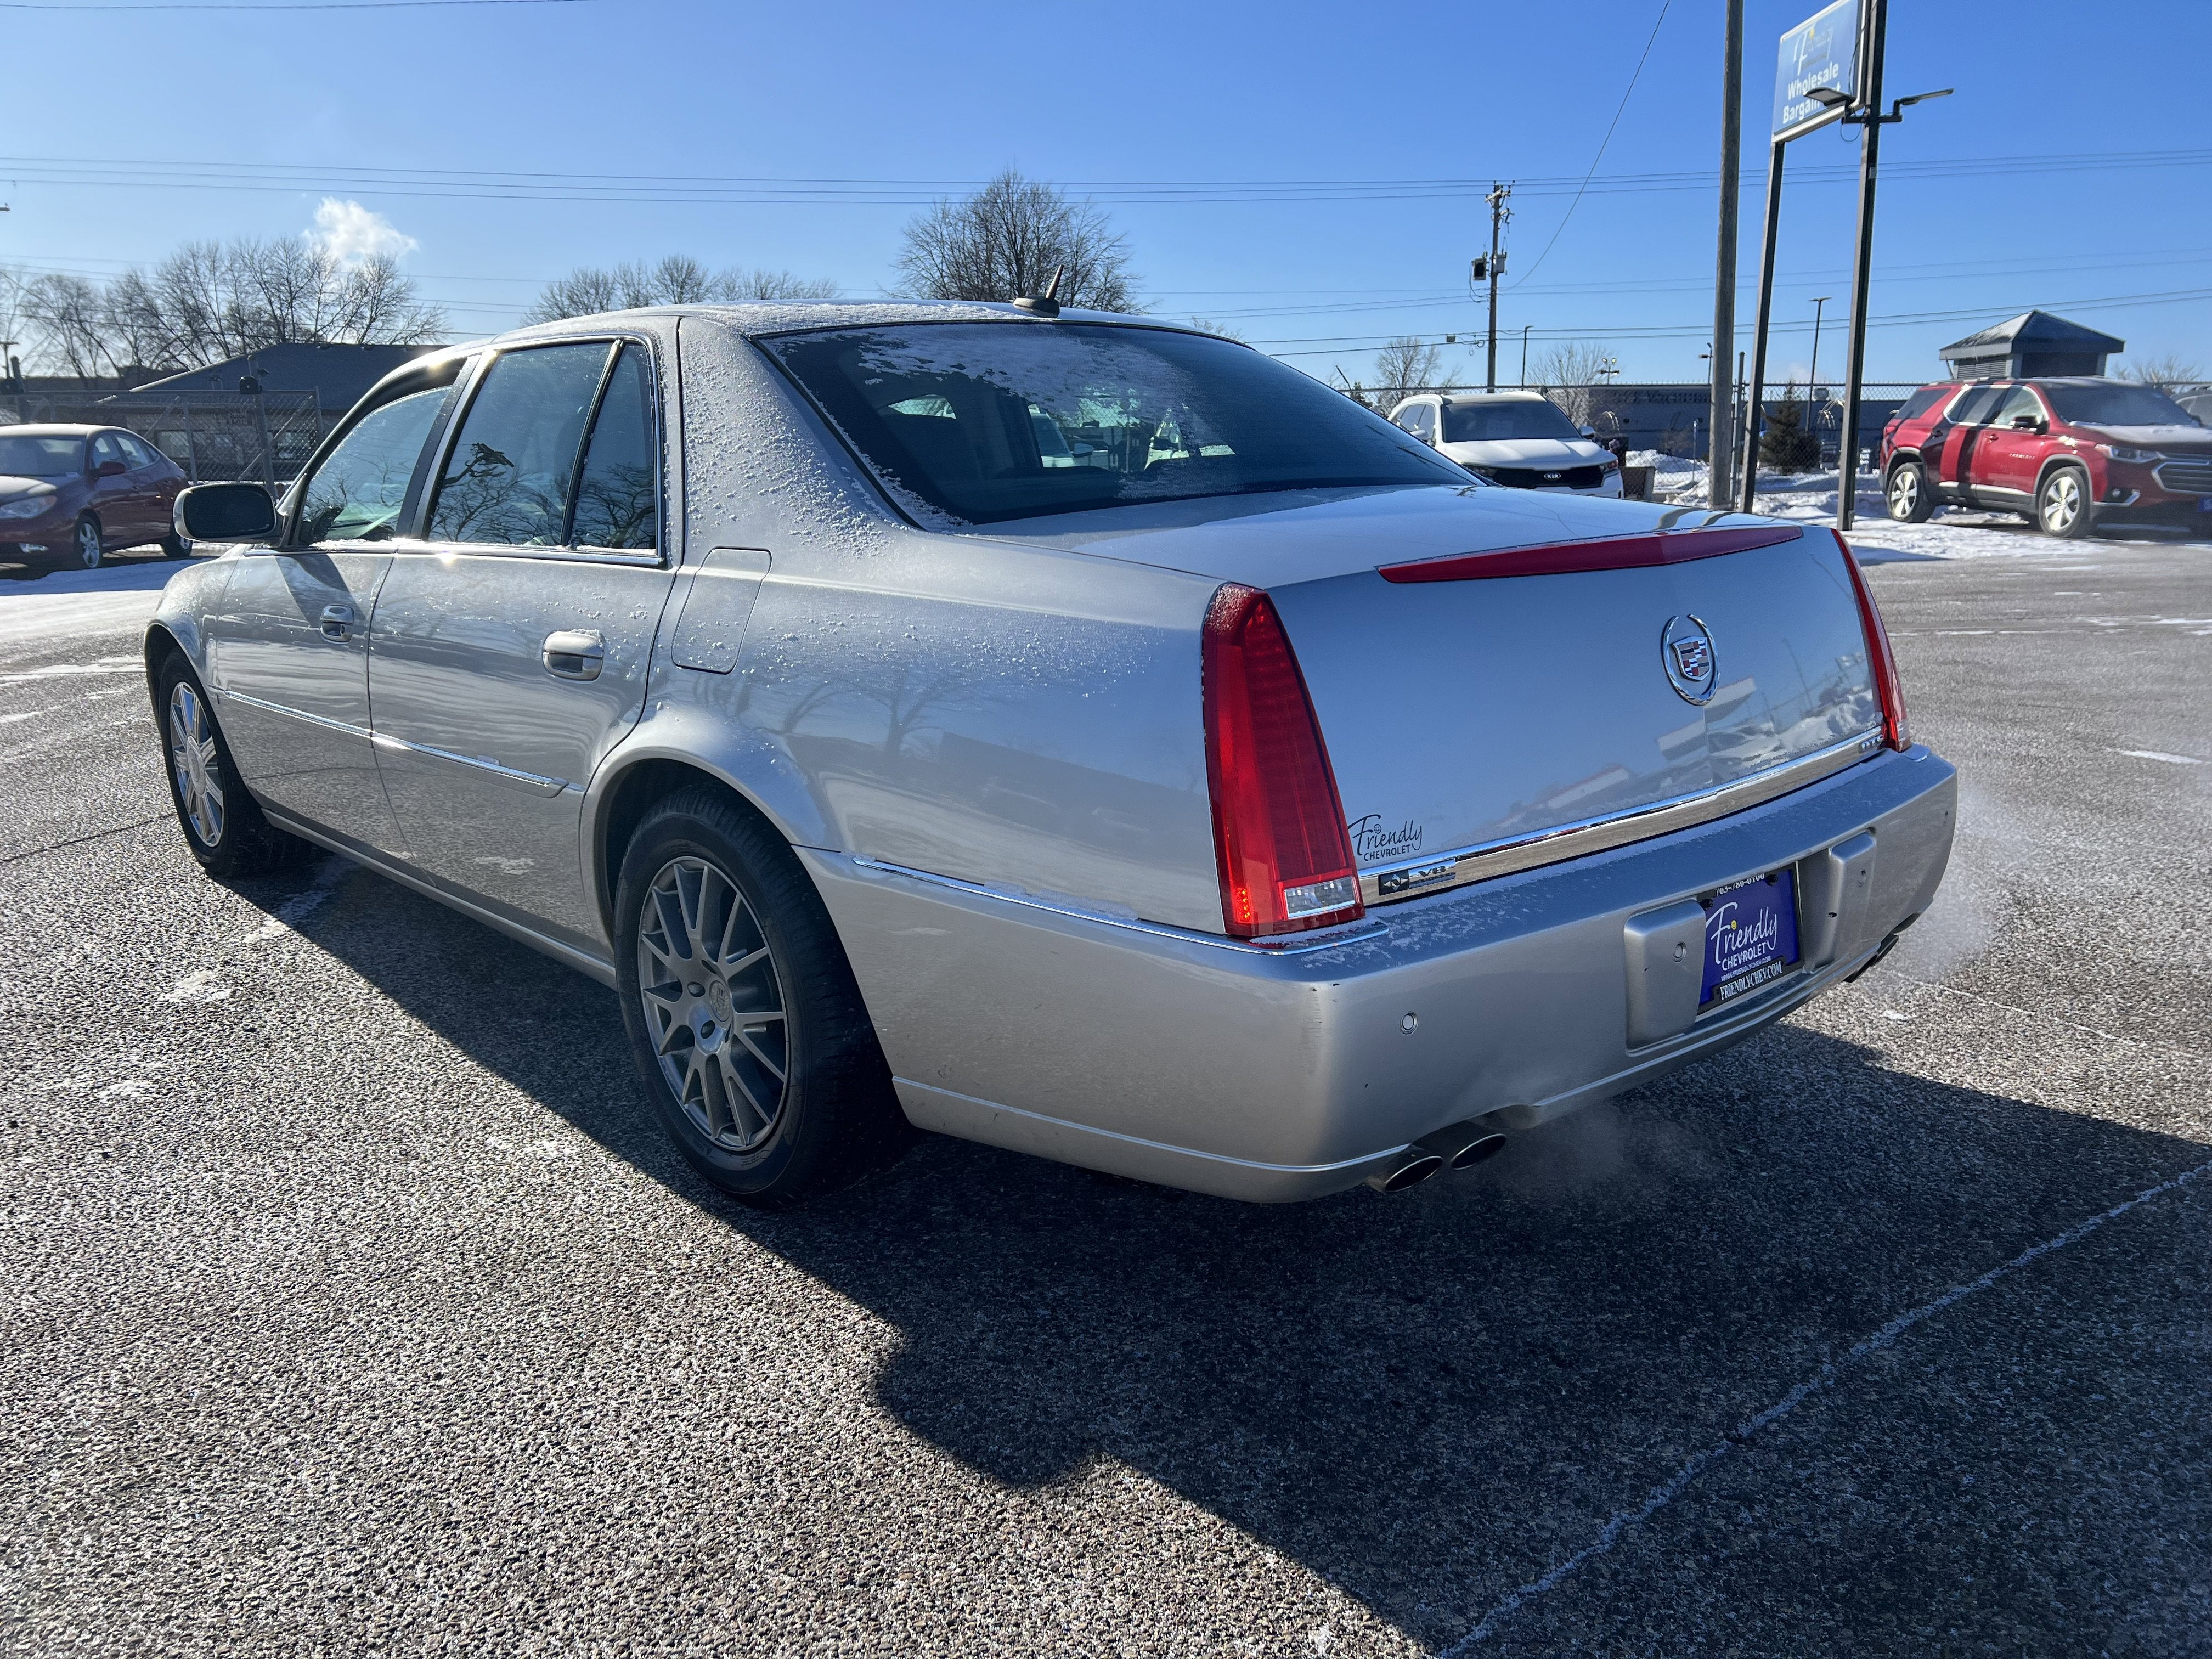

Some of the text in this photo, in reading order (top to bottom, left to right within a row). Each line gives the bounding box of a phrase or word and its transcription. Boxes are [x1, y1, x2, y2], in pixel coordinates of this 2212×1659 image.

[1788, 61, 1839, 100] Wholesale
[1347, 814, 1422, 856] Friendly
[1364, 844, 1410, 861] CHEVROLET
[1417, 865, 1446, 877] V8
[1705, 901, 1777, 964] Friendly
[1722, 942, 1767, 971] CHEVROLET
[1719, 961, 1783, 1000] FRIENDLYCHEV.COM
